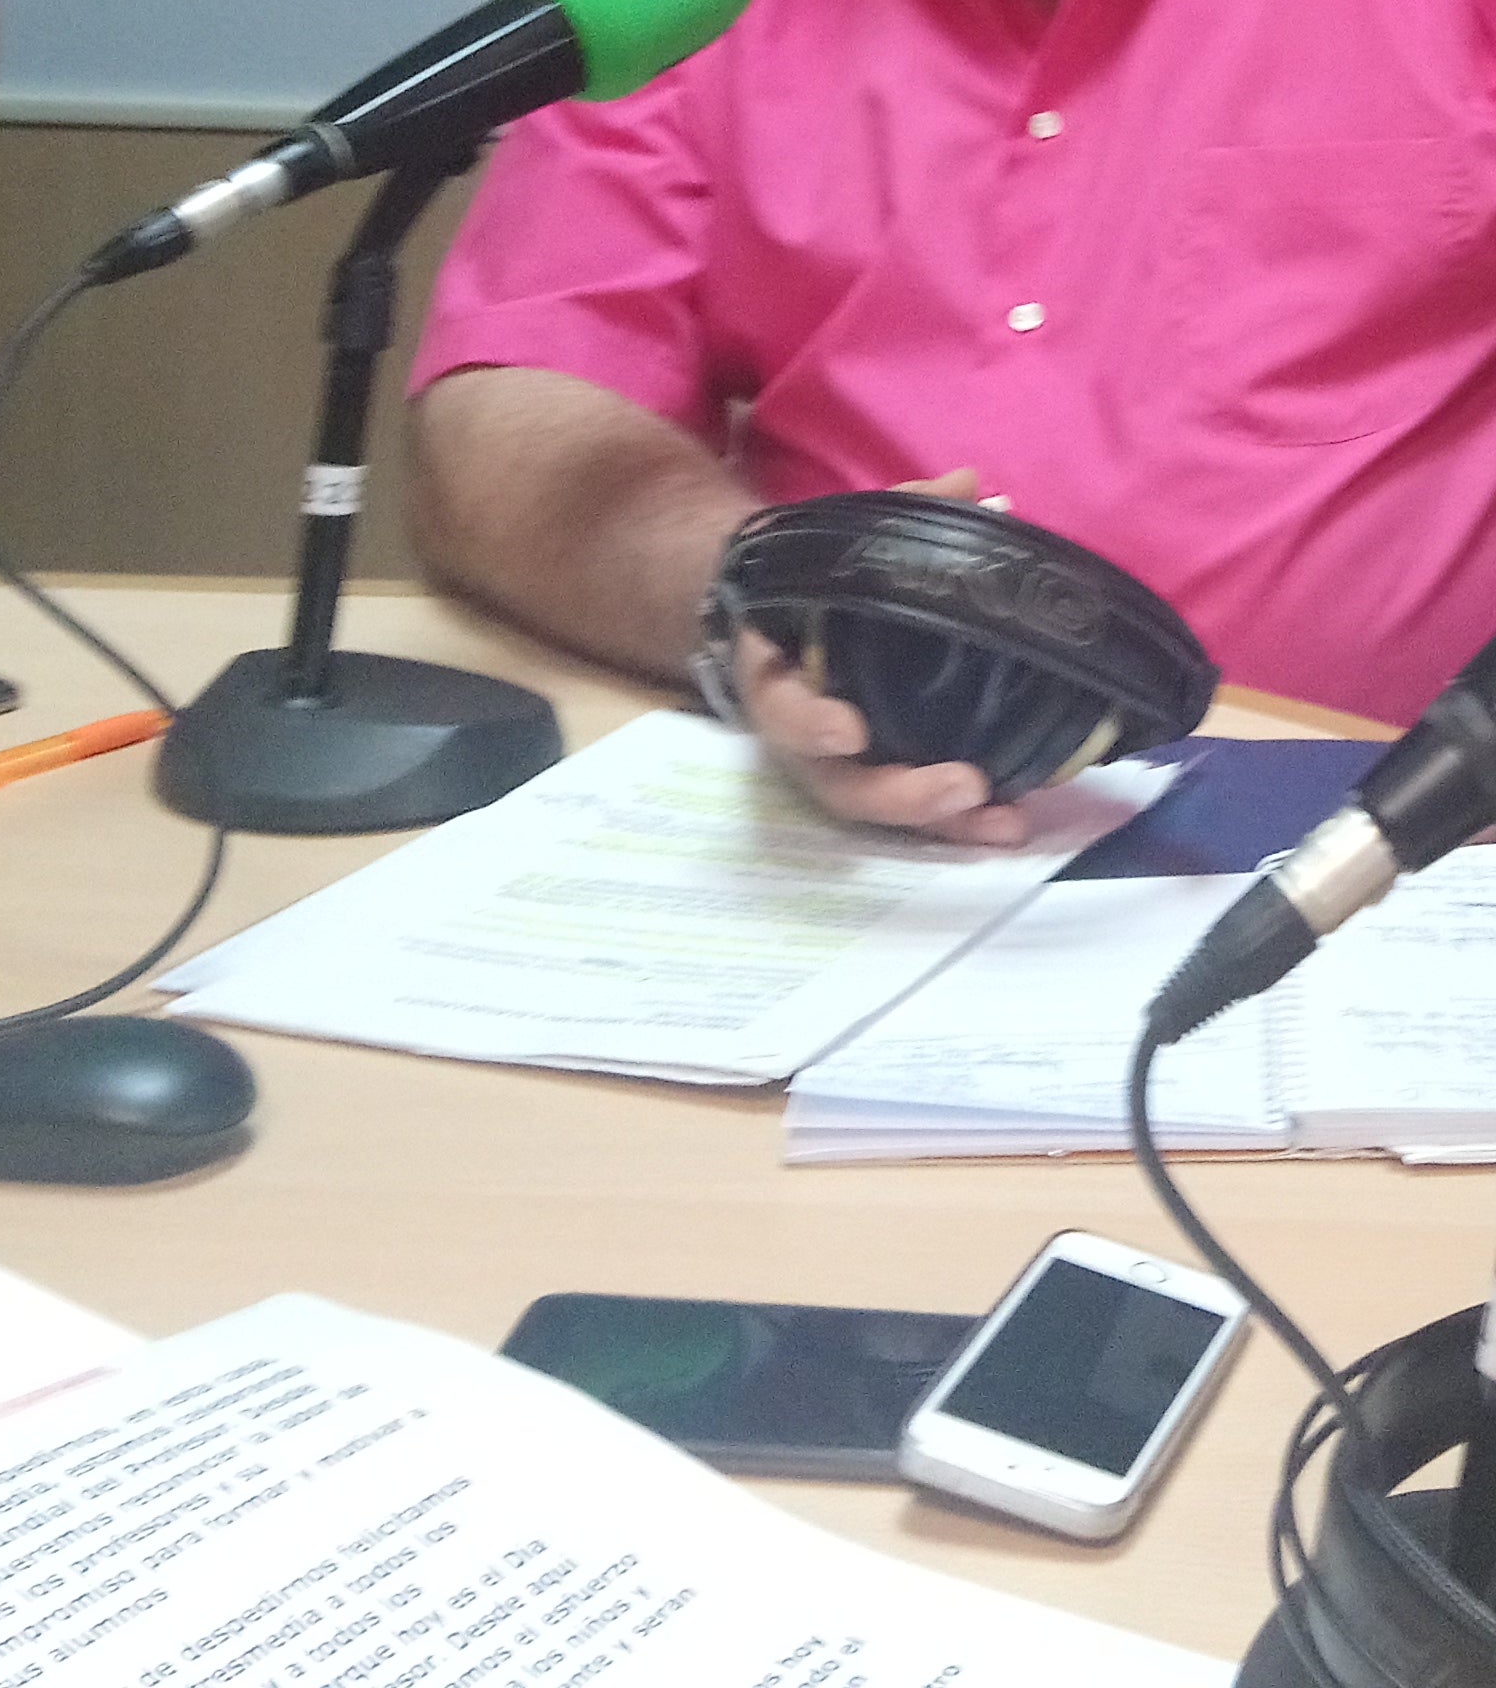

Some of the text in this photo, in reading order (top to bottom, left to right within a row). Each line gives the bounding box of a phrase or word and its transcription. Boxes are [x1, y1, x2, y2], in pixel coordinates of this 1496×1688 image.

[64, 1426, 173, 1478] estamos
[80, 1477, 123, 1501] del
[238, 1384, 319, 1420] Desde
[118, 1444, 240, 1509] reconocer
[16, 1572, 67, 1601] los
[68, 1492, 212, 1576] profesores
[141, 1530, 205, 1572] para
[201, 1479, 290, 1528] formar
[324, 1593, 347, 1611] a
[344, 1545, 420, 1594] todos
[416, 1520, 459, 1545] los
[47, 1586, 169, 1664] alumnos
[139, 1475, 473, 1688] de despedirnos felicitamos
[393, 1608, 447, 1643] hoy
[447, 1585, 478, 1611] es
[479, 1566, 506, 1589] el
[445, 1594, 528, 1652] Desde
[514, 1624, 542, 1647] el
[541, 1552, 640, 1627] esfuerzo
[284, 1662, 308, 1679] a
[304, 1609, 382, 1663] todos
[382, 1582, 424, 1610] los
[527, 1647, 567, 1678] los
[565, 1596, 632, 1645] niños
[631, 1584, 652, 1602] y
[612, 1637, 634, 1655] y
